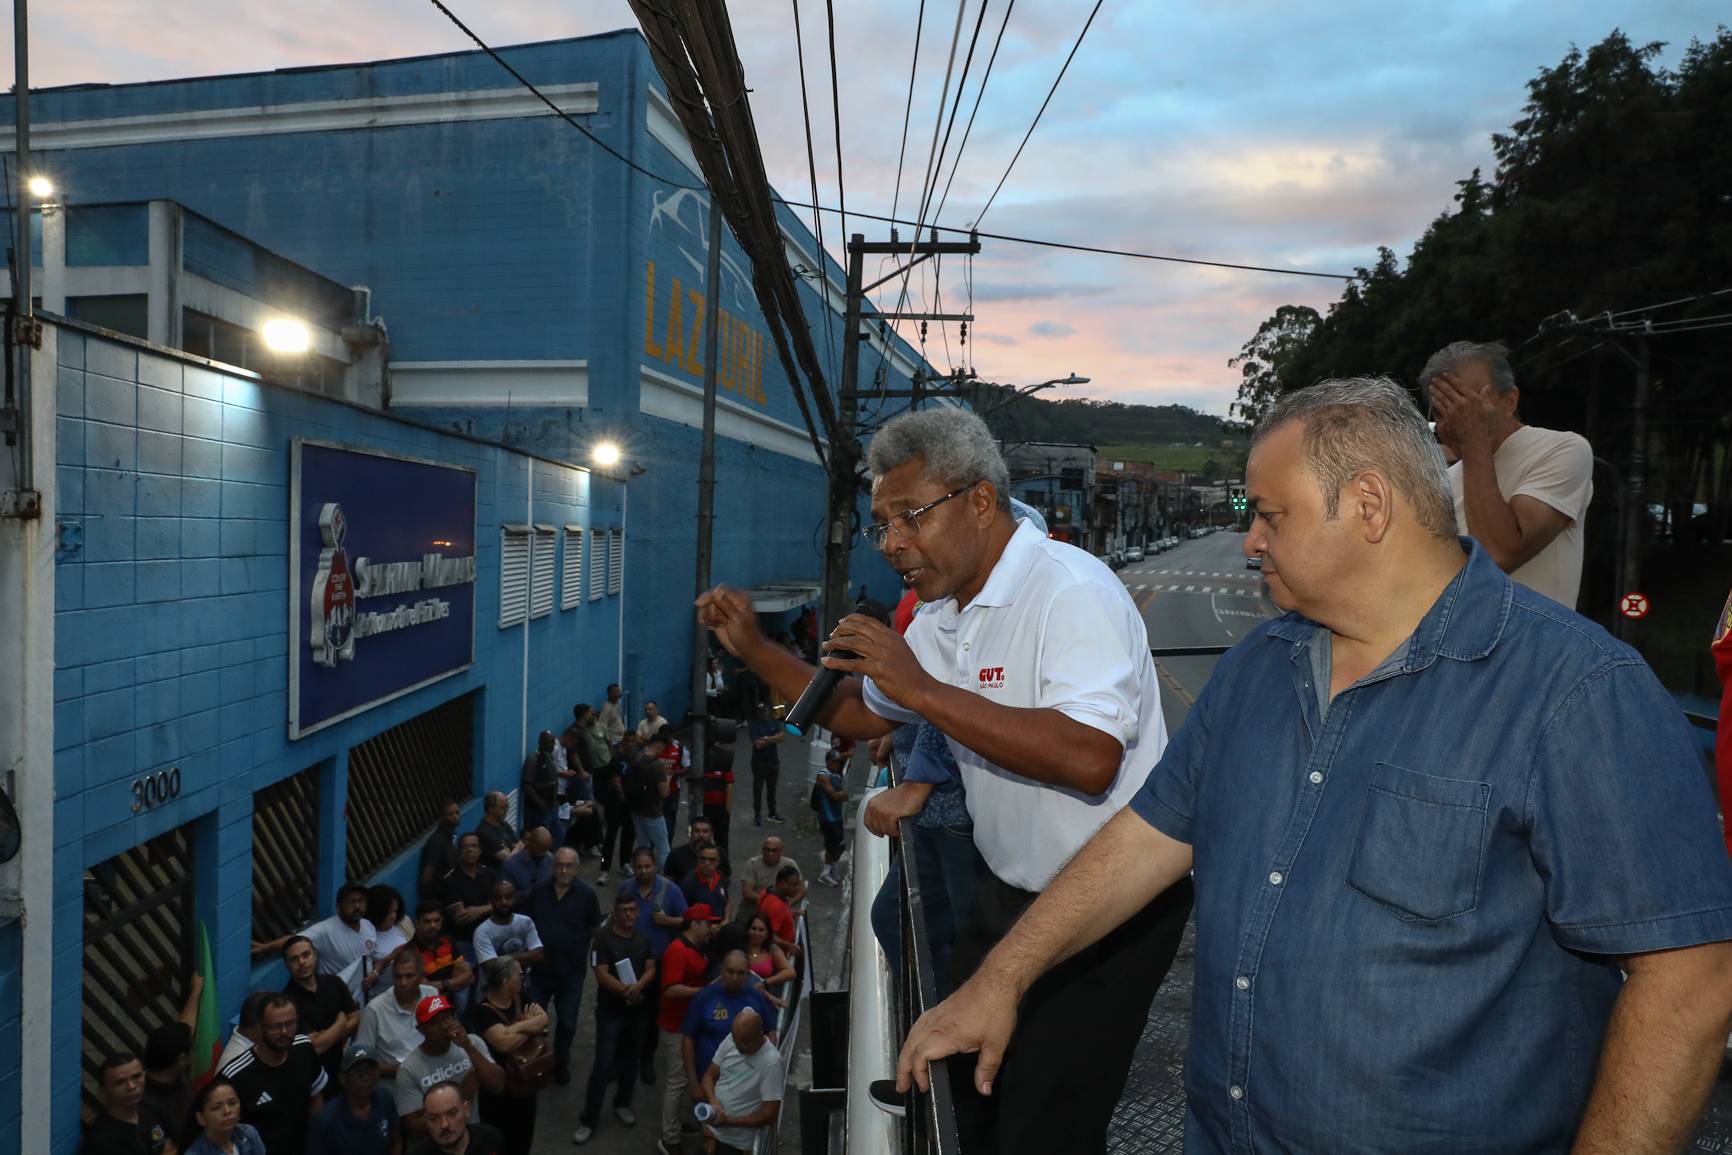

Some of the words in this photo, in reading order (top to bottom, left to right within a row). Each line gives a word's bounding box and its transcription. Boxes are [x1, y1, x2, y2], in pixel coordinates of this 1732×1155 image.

[131, 767, 181, 813] 3000
[713, 1009, 728, 1021] 20
[421, 1059, 472, 1087] adidas
